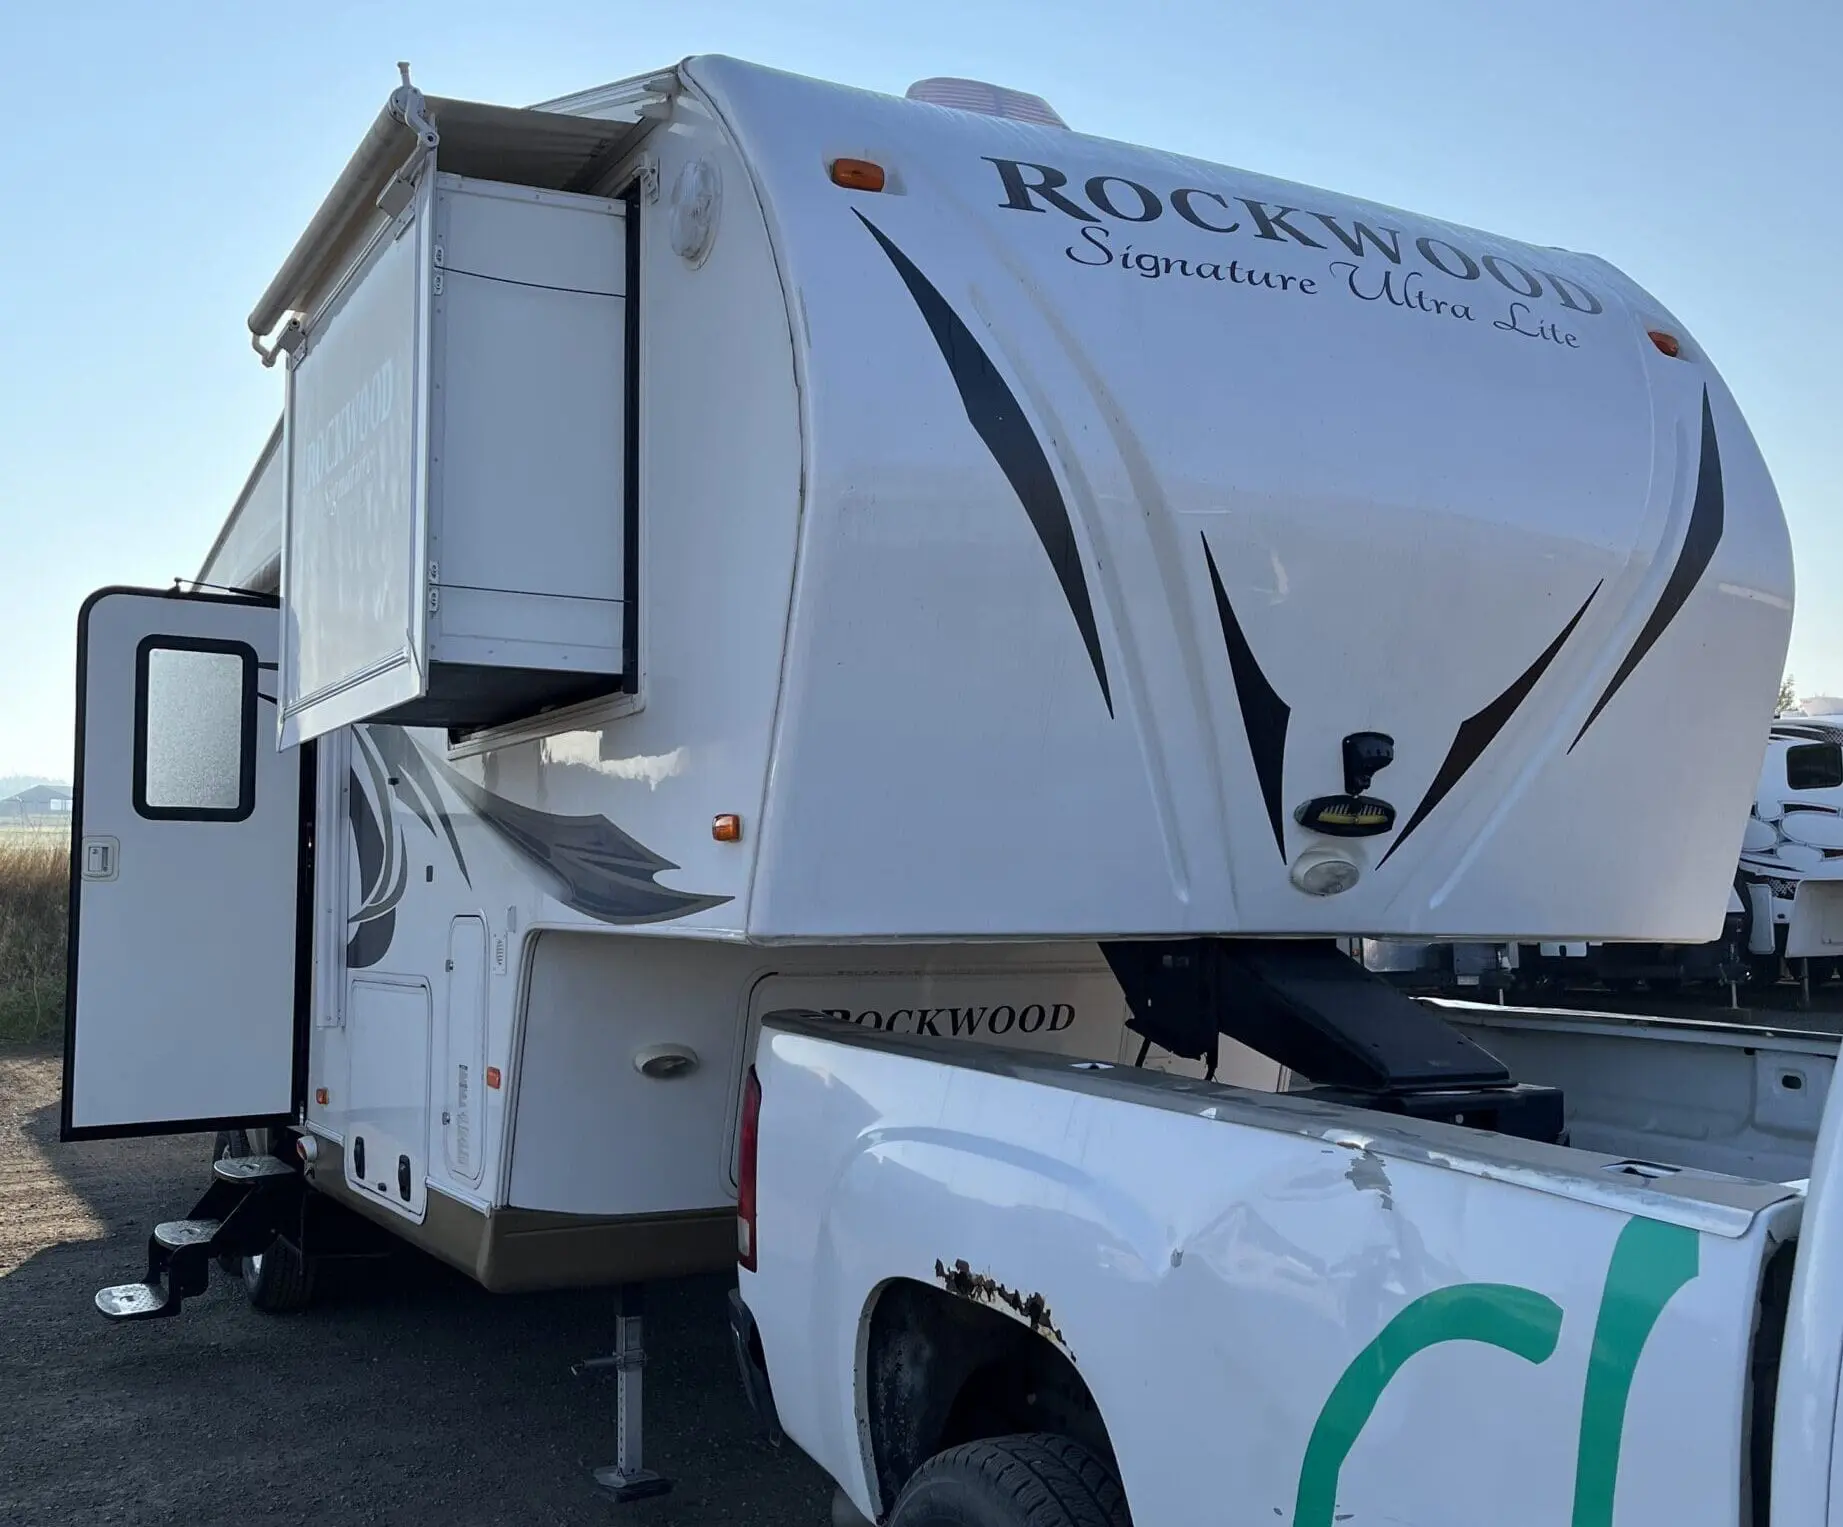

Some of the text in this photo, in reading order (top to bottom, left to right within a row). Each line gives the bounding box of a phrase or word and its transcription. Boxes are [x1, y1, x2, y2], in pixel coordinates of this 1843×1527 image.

[981, 156, 1604, 315] ROCKWOOD
[1066, 226, 1581, 349] Signature Ultra Lite
